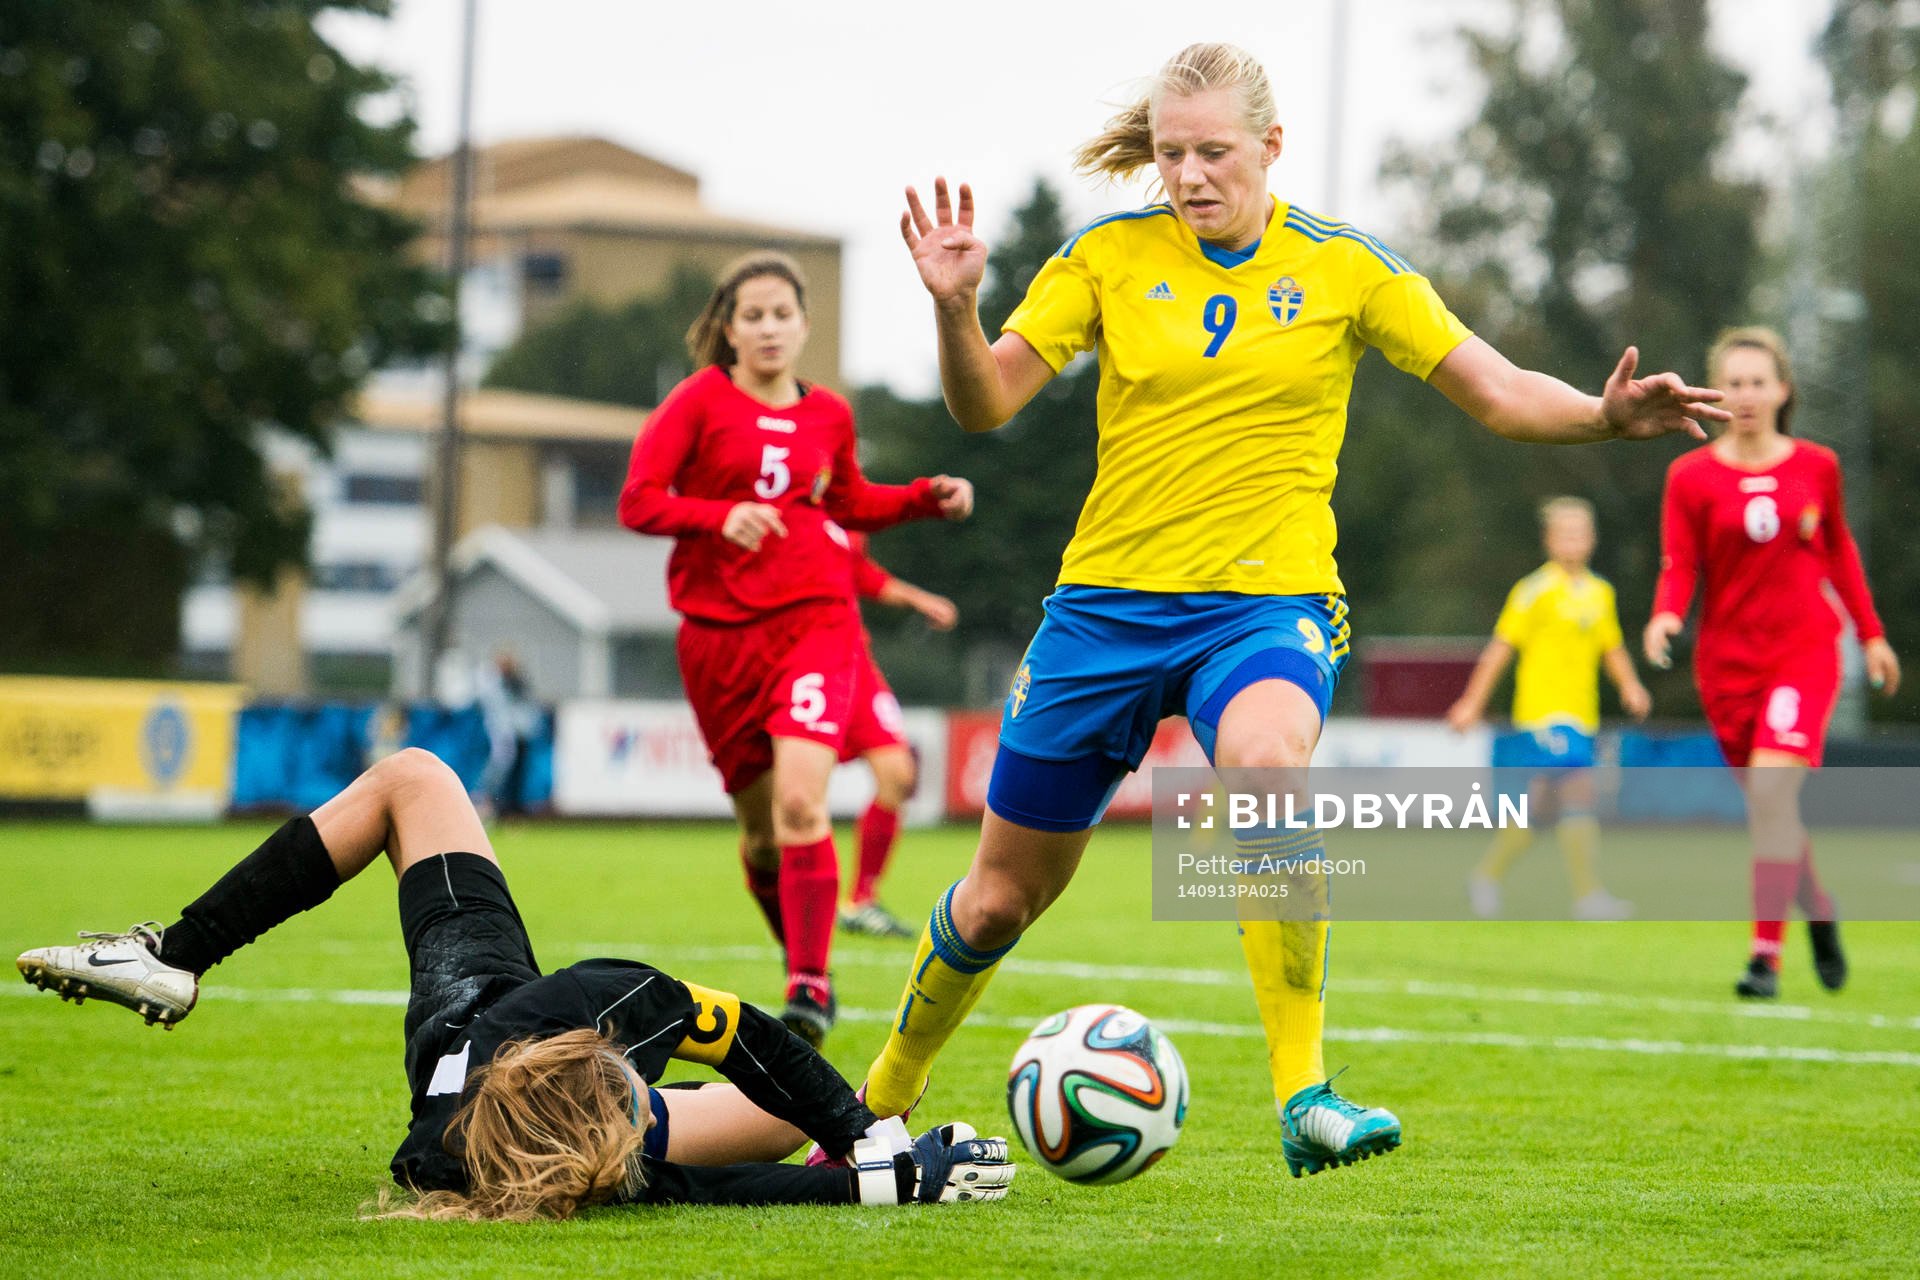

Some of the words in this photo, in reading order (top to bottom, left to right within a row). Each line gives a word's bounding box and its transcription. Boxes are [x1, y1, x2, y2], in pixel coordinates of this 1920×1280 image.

[1203, 294, 1238, 358] 9
[754, 444, 791, 499] 5
[1744, 495, 1780, 543] 6
[1297, 618, 1325, 654] 9
[790, 672, 827, 723] 5
